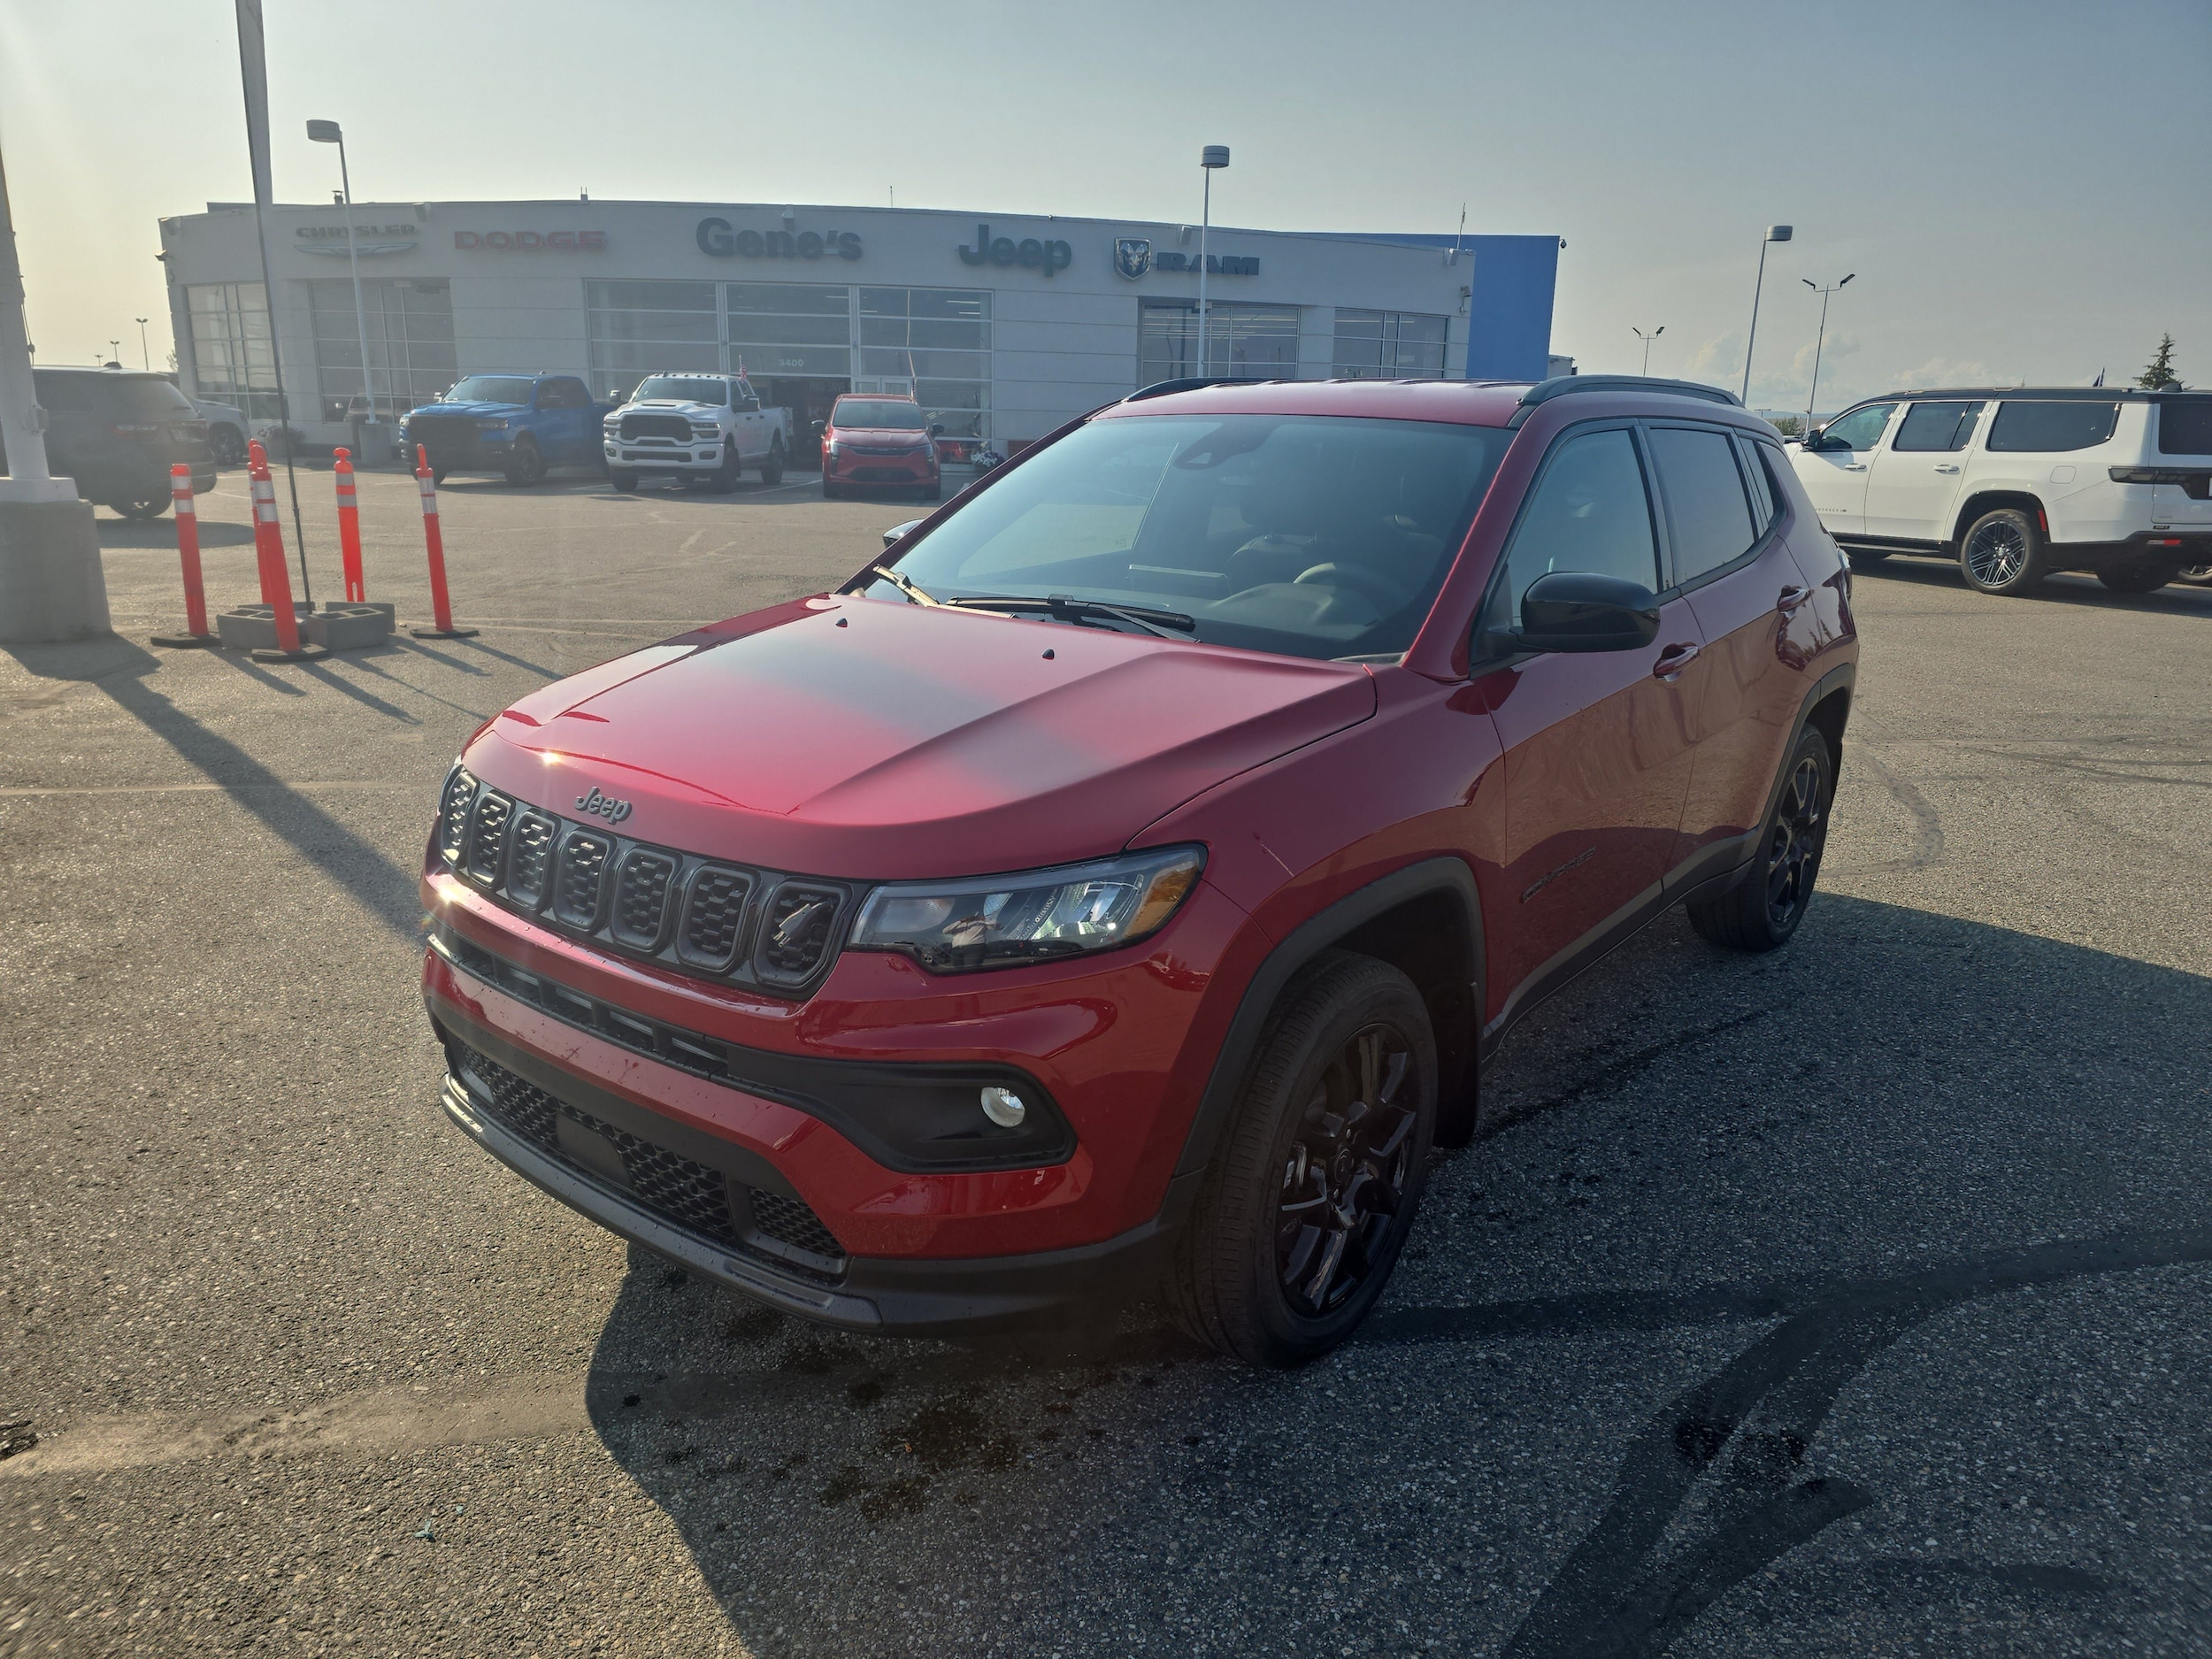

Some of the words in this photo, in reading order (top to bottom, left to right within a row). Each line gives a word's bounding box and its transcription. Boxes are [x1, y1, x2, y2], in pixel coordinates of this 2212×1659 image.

[454, 230, 605, 250] DODGE
[695, 217, 863, 260] Gene's
[958, 223, 1072, 277] Jeep
[1157, 252, 1260, 275] RAM
[779, 358, 804, 367] 3400
[574, 787, 633, 826] Jeep
